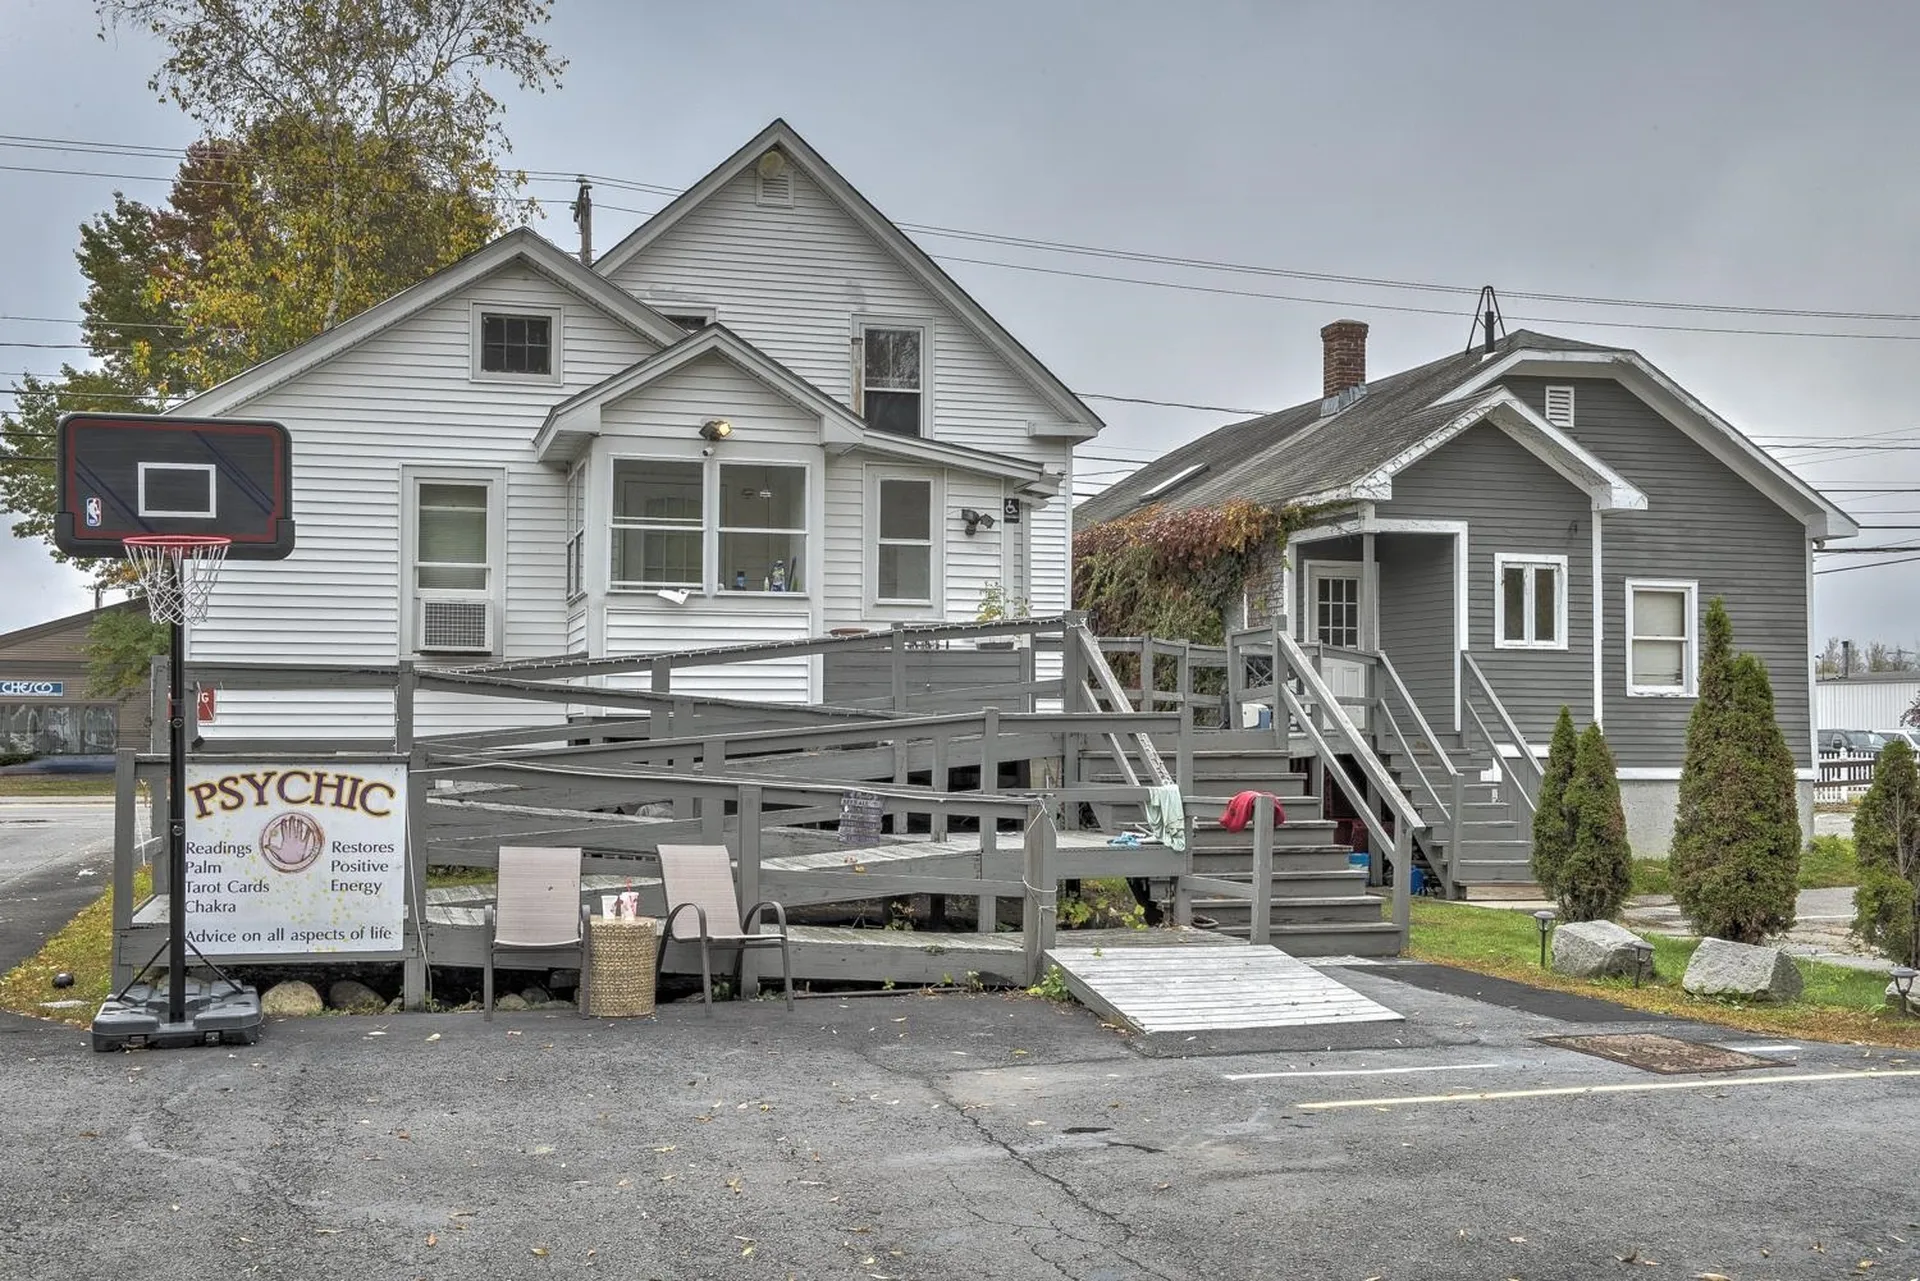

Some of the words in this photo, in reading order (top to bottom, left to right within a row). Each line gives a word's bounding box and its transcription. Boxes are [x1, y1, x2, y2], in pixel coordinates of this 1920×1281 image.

[2, 682, 53, 693] CHESCO
[188, 770, 396, 819] PSYCHIC
[186, 841, 252, 858] Readings
[332, 840, 395, 853] Restores
[185, 860, 222, 873] Palm
[331, 860, 389, 872] Positive
[185, 881, 221, 893] Tarot
[227, 879, 270, 893] Cards
[331, 879, 382, 895] Energy
[185, 899, 236, 913] Chakra
[186, 929, 236, 943] Advice
[242, 932, 261, 942] on
[267, 927, 284, 941] all
[291, 930, 345, 944] aspects
[350, 926, 365, 940] of
[370, 926, 392, 940] life
